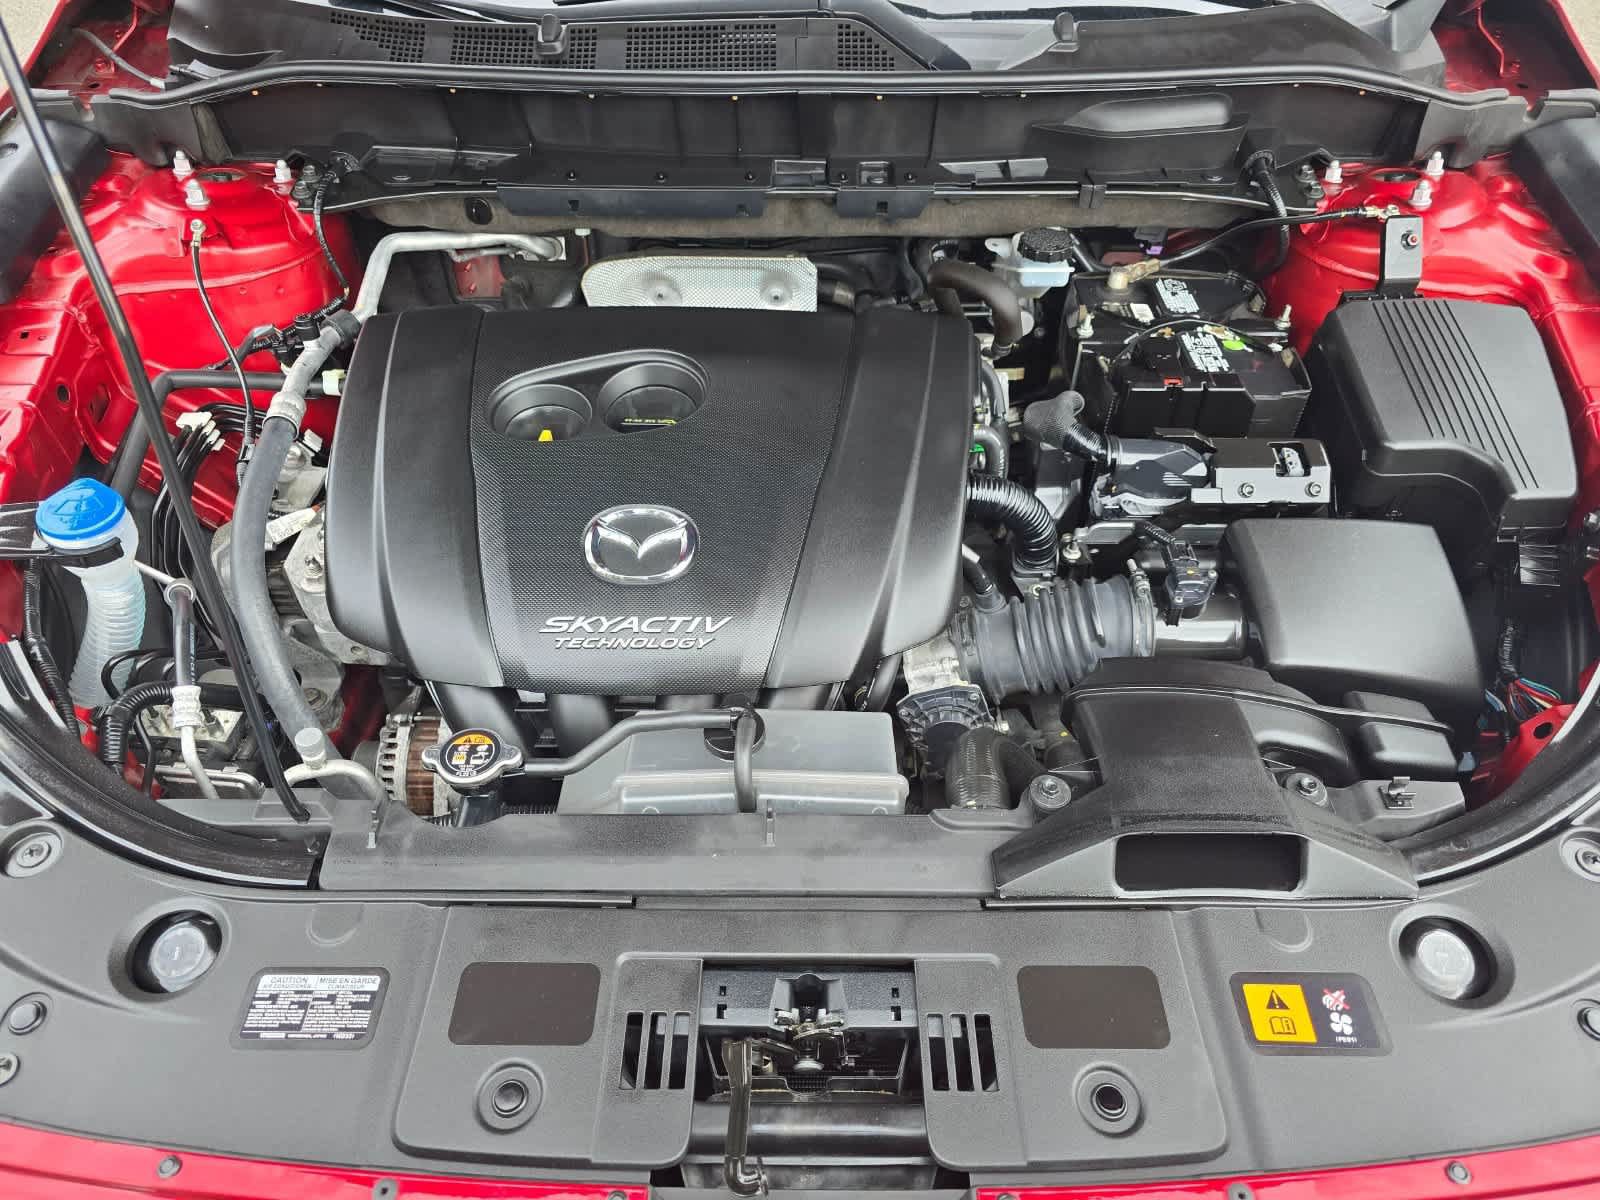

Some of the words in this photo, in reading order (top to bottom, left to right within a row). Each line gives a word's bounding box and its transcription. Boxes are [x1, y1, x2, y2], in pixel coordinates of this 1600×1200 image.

[539, 615, 733, 633] SKYACTIV
[555, 637, 716, 649] TECHNOLOGY
[270, 976, 308, 984] CAUTION
